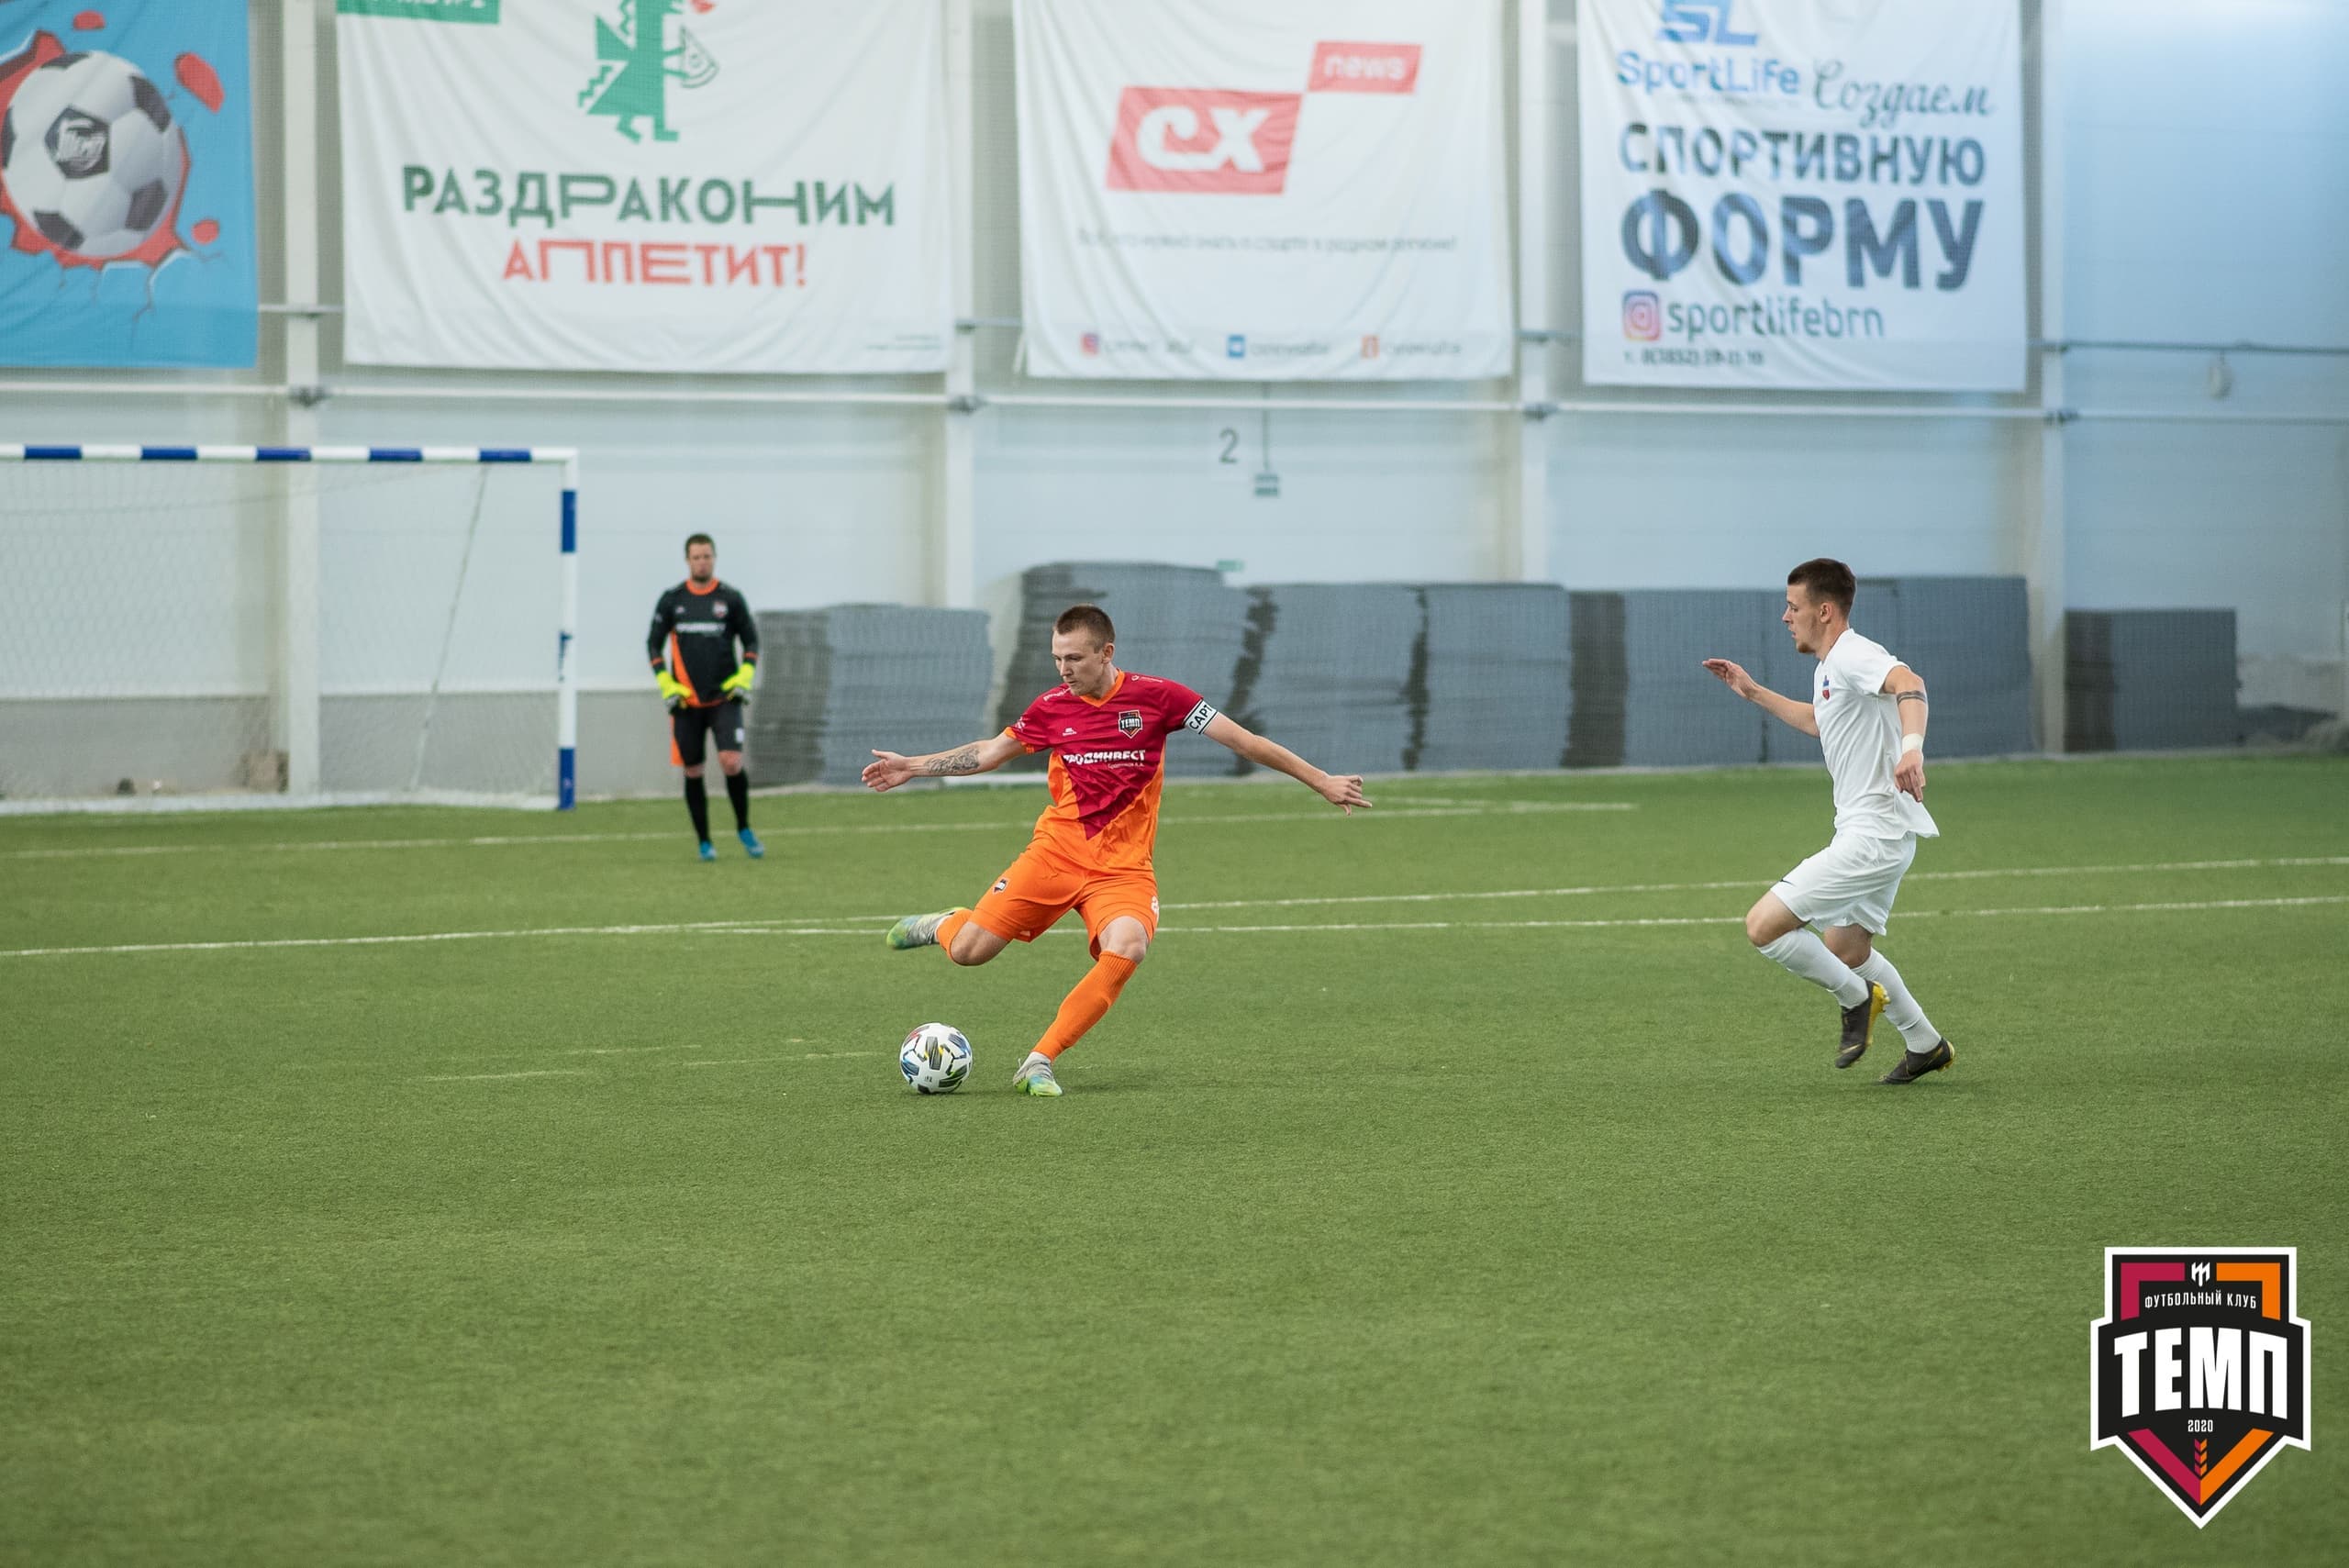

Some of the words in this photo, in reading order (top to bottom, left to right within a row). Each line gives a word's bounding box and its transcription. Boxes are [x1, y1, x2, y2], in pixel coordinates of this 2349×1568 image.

[1324, 53, 1406, 81] news
[1616, 50, 1800, 95] SportLife
[1620, 122, 1986, 184] СПОРТИВНУЮ
[402, 164, 896, 228] РАЗДРАКОНИМ
[1620, 188, 1984, 291] ФОРМУ
[502, 239, 807, 287] АППЕТИТ!
[1667, 295, 1885, 340] sportlifebrn
[1219, 427, 1239, 463] 2
[1189, 704, 1212, 729] CAPT
